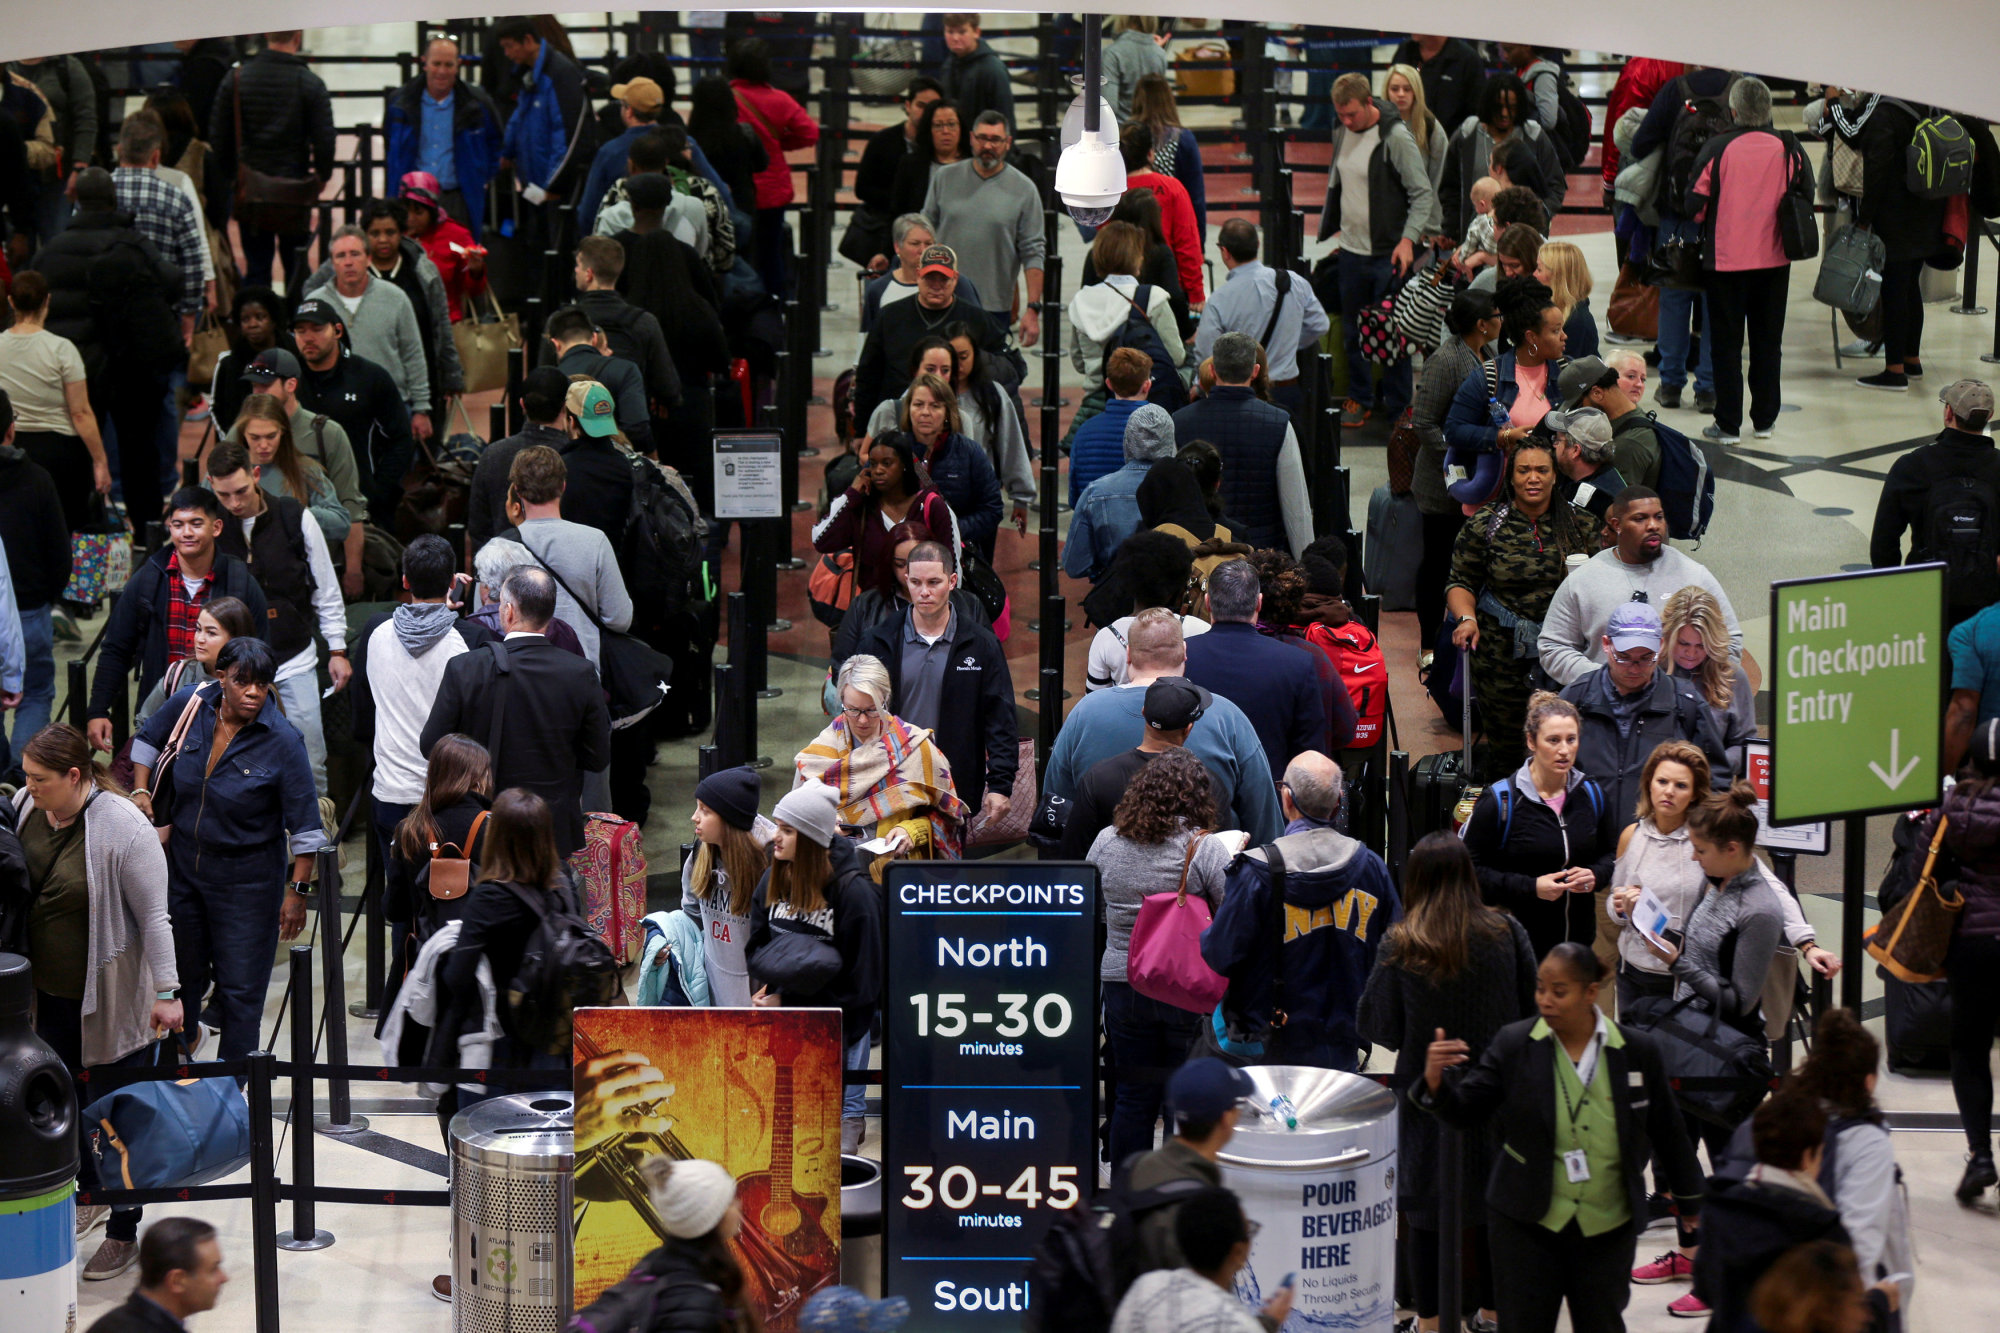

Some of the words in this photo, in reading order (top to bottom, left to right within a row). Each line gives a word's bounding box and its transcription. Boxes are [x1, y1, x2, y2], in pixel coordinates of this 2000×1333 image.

[1787, 596, 1847, 634] Main
[1786, 632, 1926, 679] Checkpoint
[1786, 689, 1853, 724] Entry
[900, 884, 1084, 904] CHECKPOINTS
[1283, 888, 1378, 943] NAVY
[711, 920, 731, 943] CA
[938, 936, 1047, 967] North
[910, 993, 1072, 1037] 15-30
[959, 1041, 1024, 1056] minutes
[948, 1109, 1035, 1139] Main
[902, 1165, 1079, 1209] 30-45
[1302, 1179, 1357, 1207] POUR
[958, 1213, 1022, 1227] minutes
[1301, 1197, 1393, 1238] BEVERAGES
[488, 1237, 515, 1247] ATLANTA
[1301, 1243, 1351, 1270] HERE
[1302, 1278, 1319, 1288] No
[1322, 1272, 1358, 1288] Liquids
[1302, 1290, 1347, 1305] Through
[1350, 1282, 1381, 1299] Security
